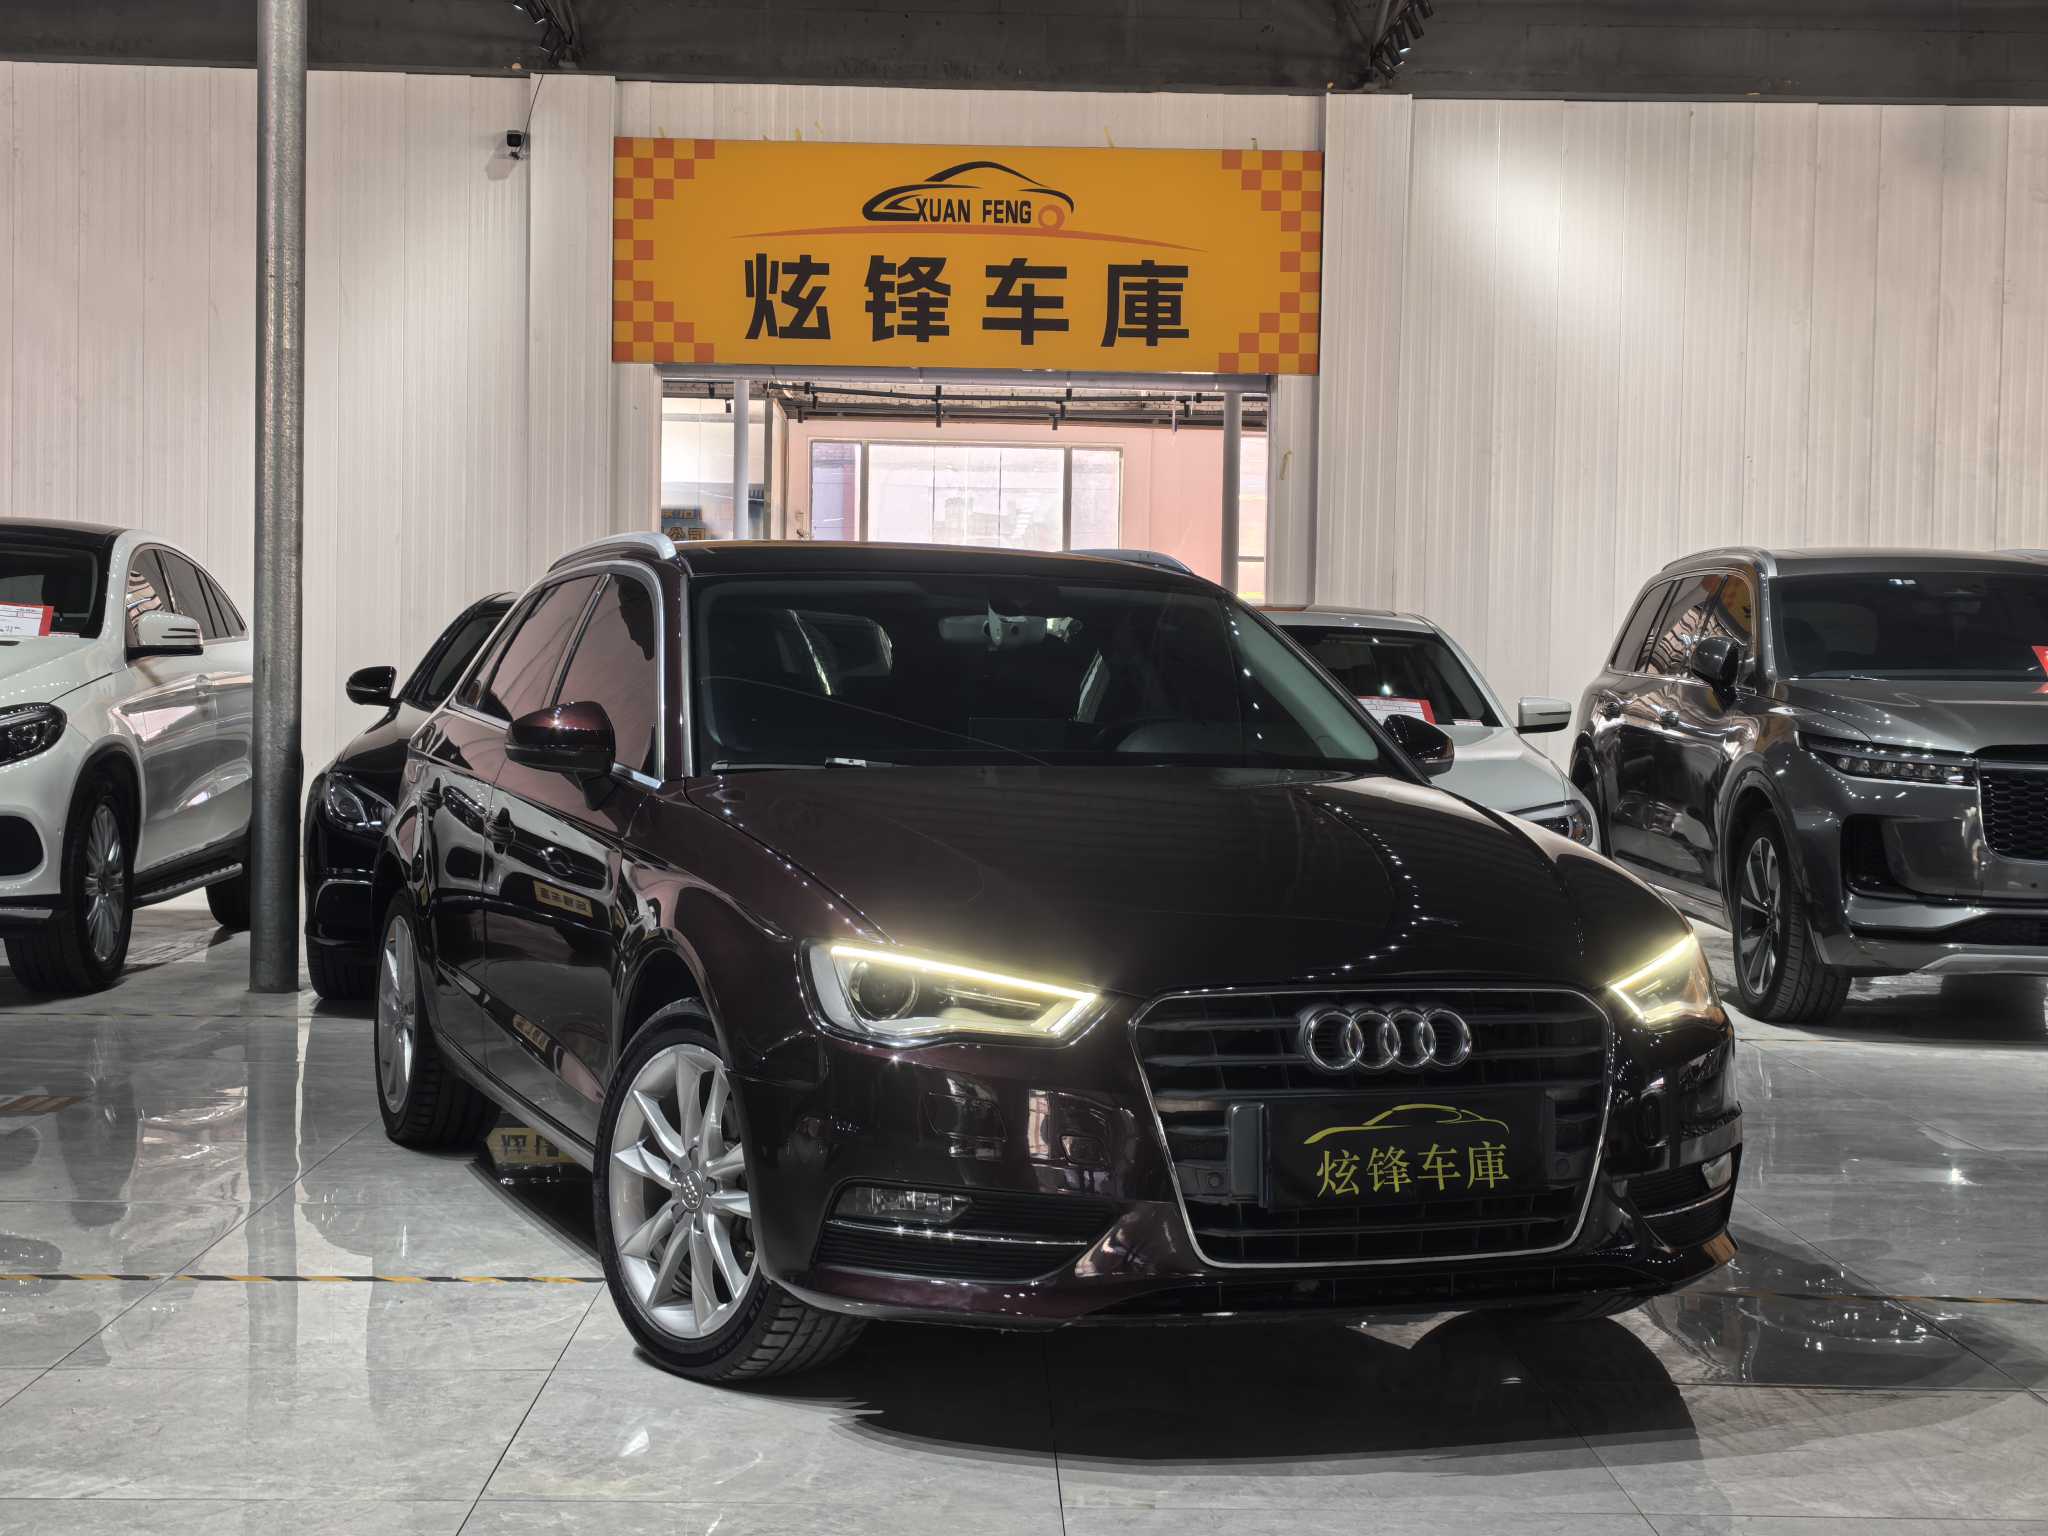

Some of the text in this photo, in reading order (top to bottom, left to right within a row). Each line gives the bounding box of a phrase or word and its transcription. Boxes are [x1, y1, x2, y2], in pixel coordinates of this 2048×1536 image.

[914, 198, 1032, 225] XUAN FENG
[744, 253, 1190, 348] 炫锋车庫
[1315, 1139, 1512, 1198] 炫锋车庫
